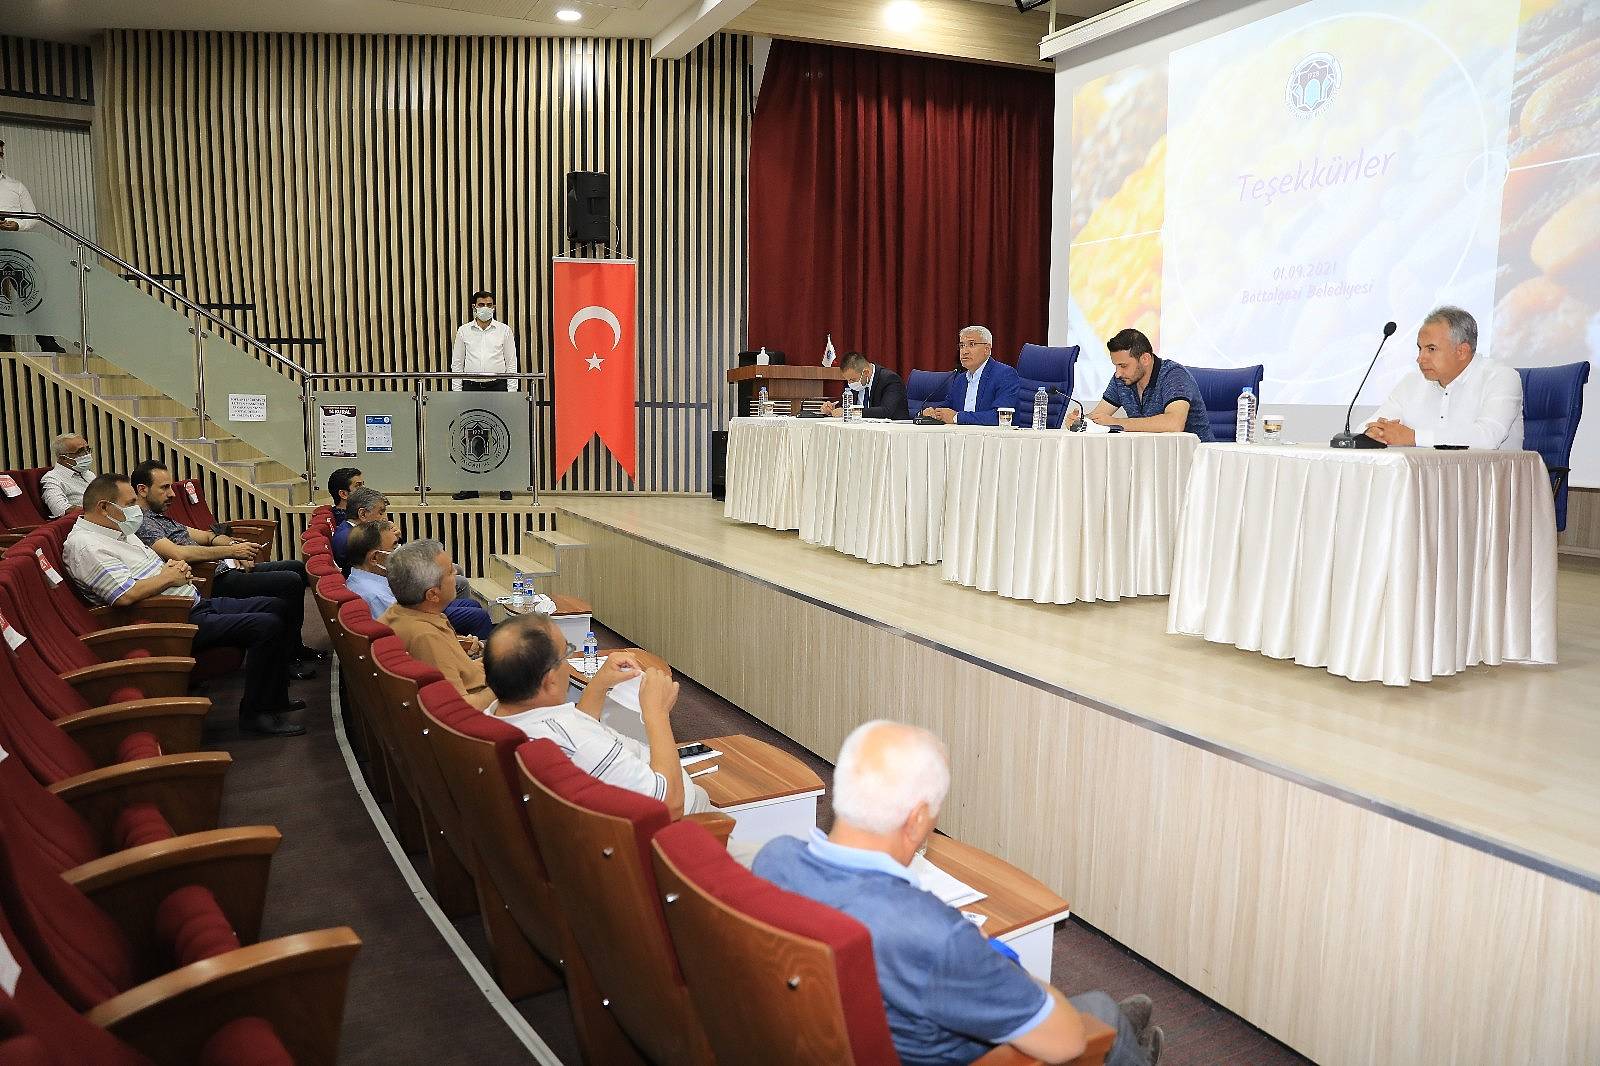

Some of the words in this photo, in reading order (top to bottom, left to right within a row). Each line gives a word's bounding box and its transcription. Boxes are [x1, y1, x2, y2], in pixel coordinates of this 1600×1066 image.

[1238, 147, 1396, 207] Teşekkürler
[1272, 261, 1337, 281] 01.09.2021
[1241, 286, 1303, 305] Battalgazi
[1307, 278, 1374, 300] Belediyesi
